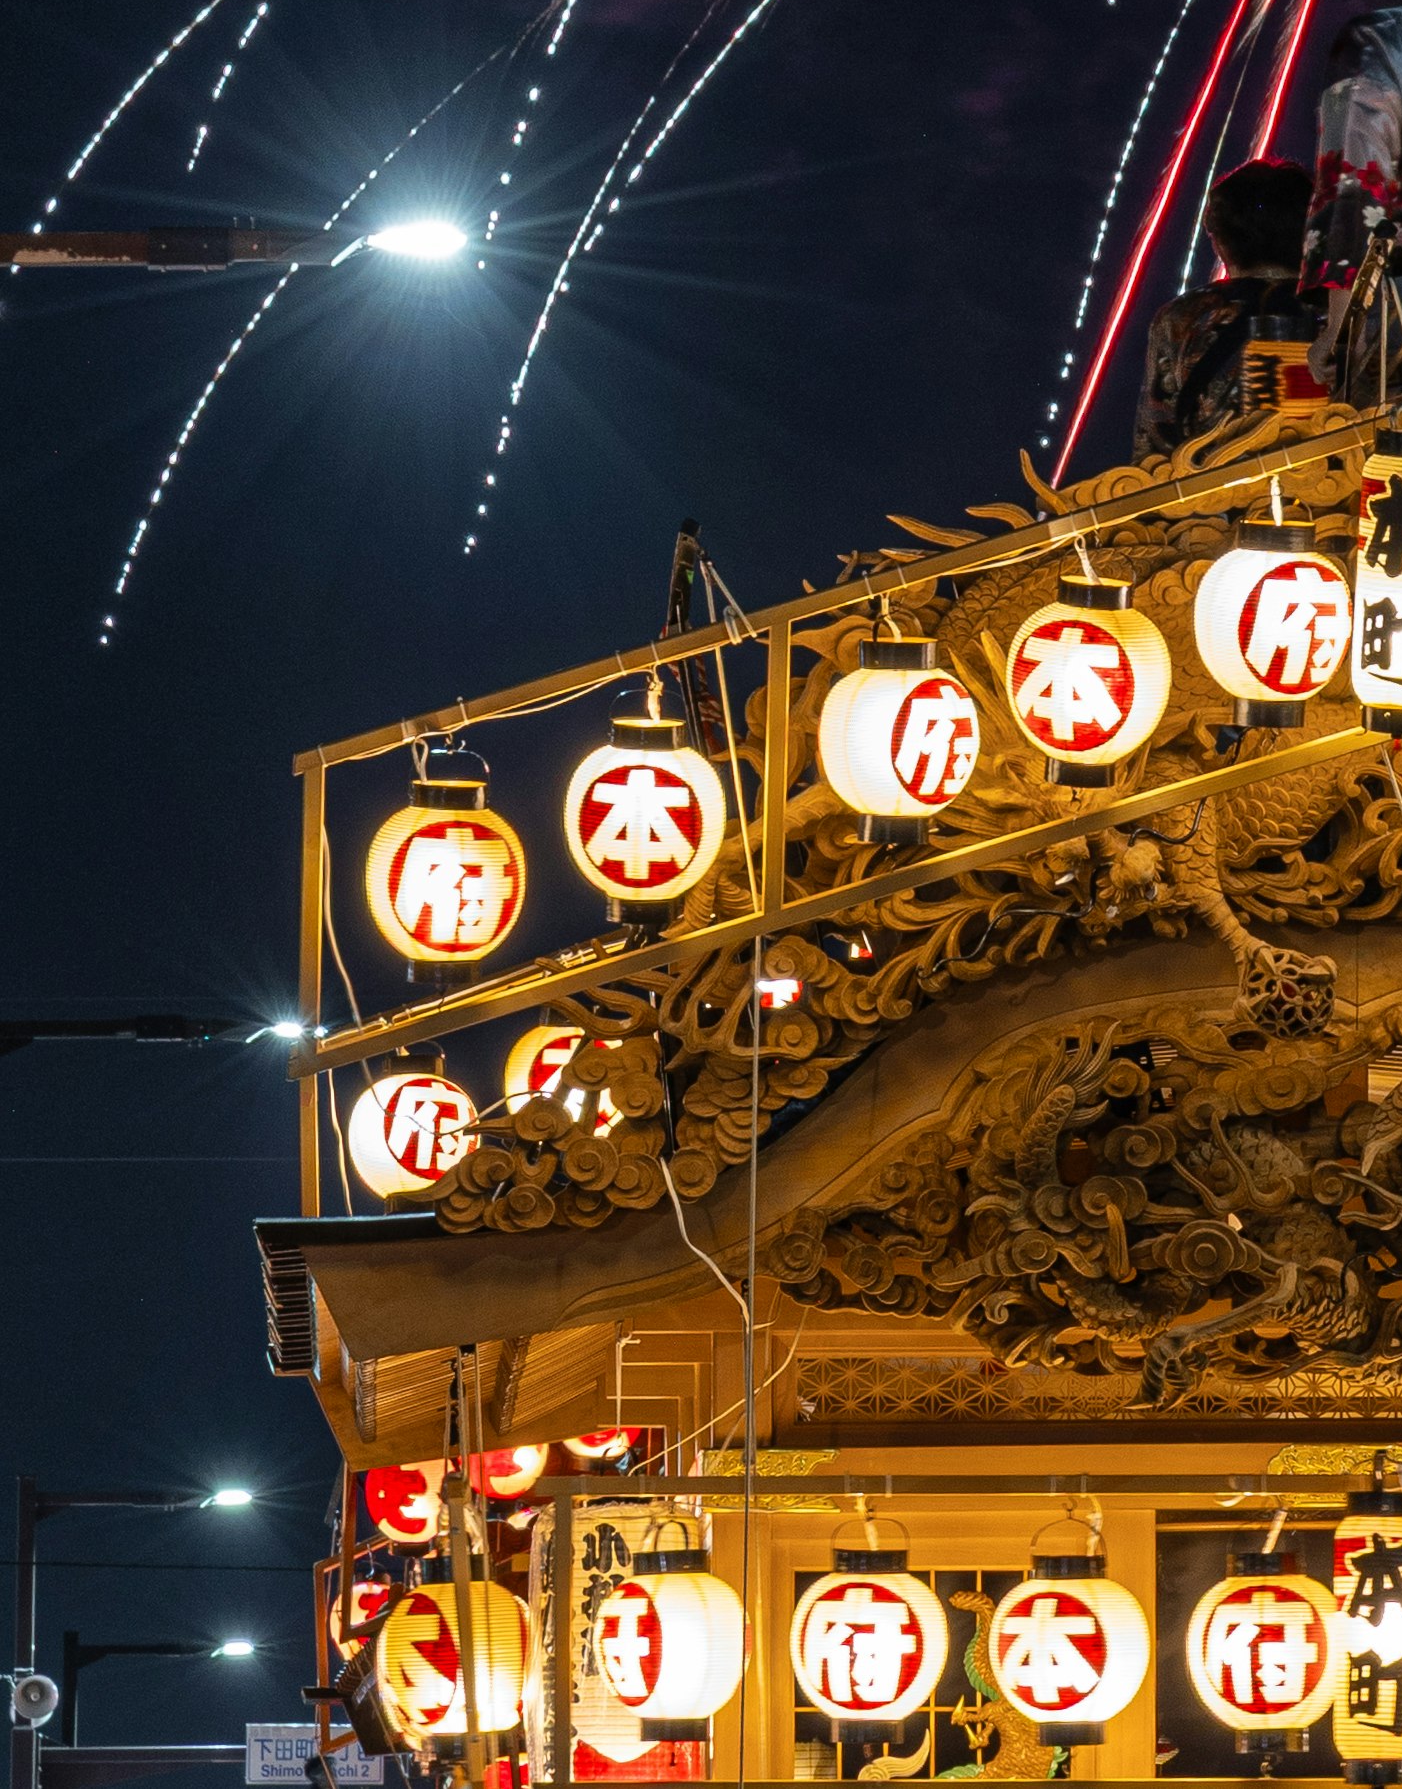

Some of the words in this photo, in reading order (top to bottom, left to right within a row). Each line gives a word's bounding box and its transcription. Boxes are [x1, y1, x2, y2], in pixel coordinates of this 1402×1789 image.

[1014, 628, 1122, 740] 本
[586, 770, 697, 879] 本
[1001, 1598, 1101, 1703] 本
[361, 1765, 370, 1777] 2
